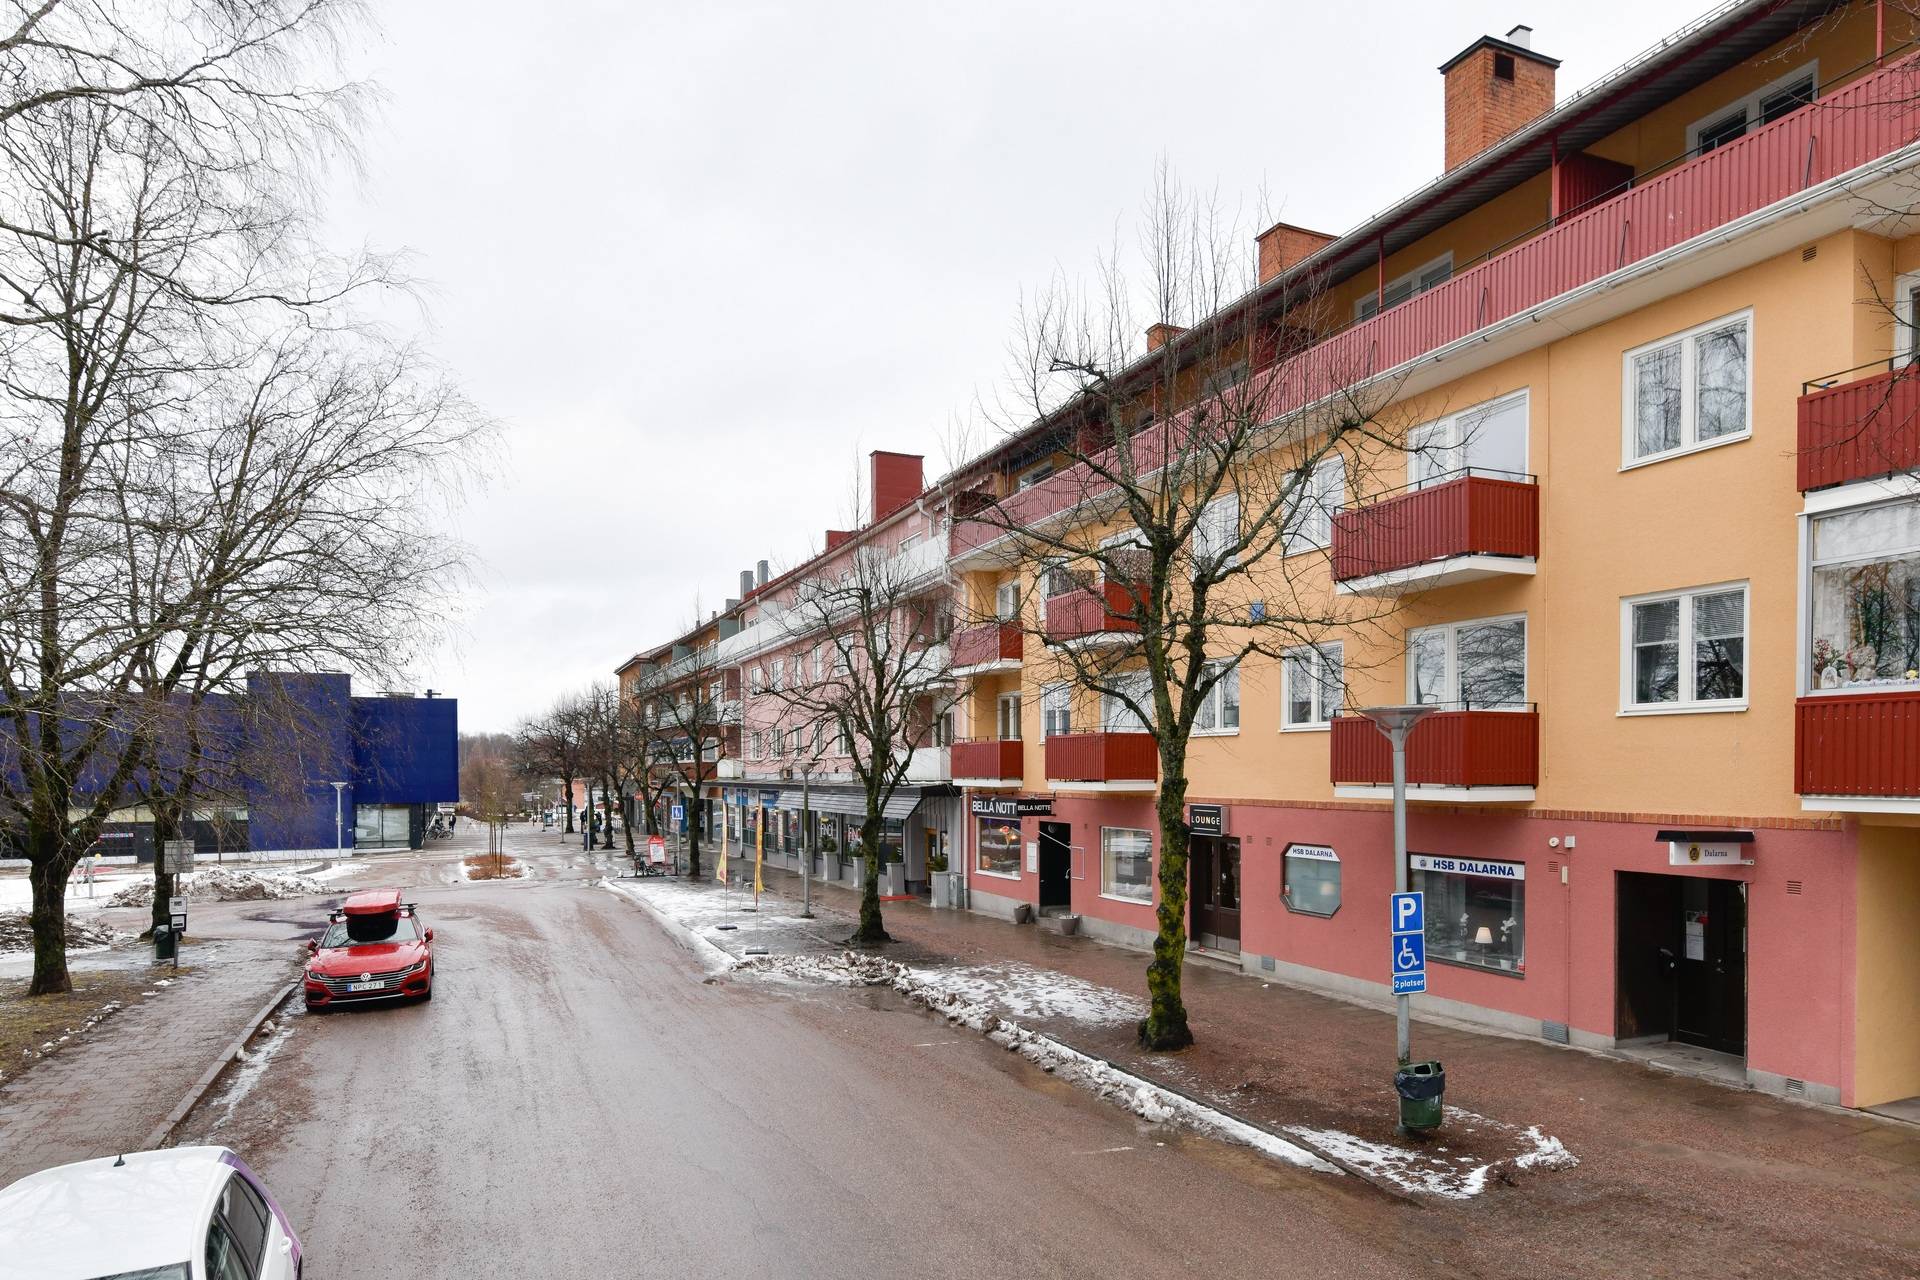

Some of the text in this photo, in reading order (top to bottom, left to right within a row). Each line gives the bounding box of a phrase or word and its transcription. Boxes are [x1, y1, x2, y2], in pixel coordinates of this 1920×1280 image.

[972, 801, 994, 813] BELLA
[1191, 816, 1220, 825] LOUNGE
[1305, 849, 1333, 857] DALARNA
[1704, 849, 1728, 857] Dalarna
[1433, 859, 1515, 876] HSB DALARNA
[1398, 897, 1417, 929] P
[1400, 979, 1424, 989] platser
